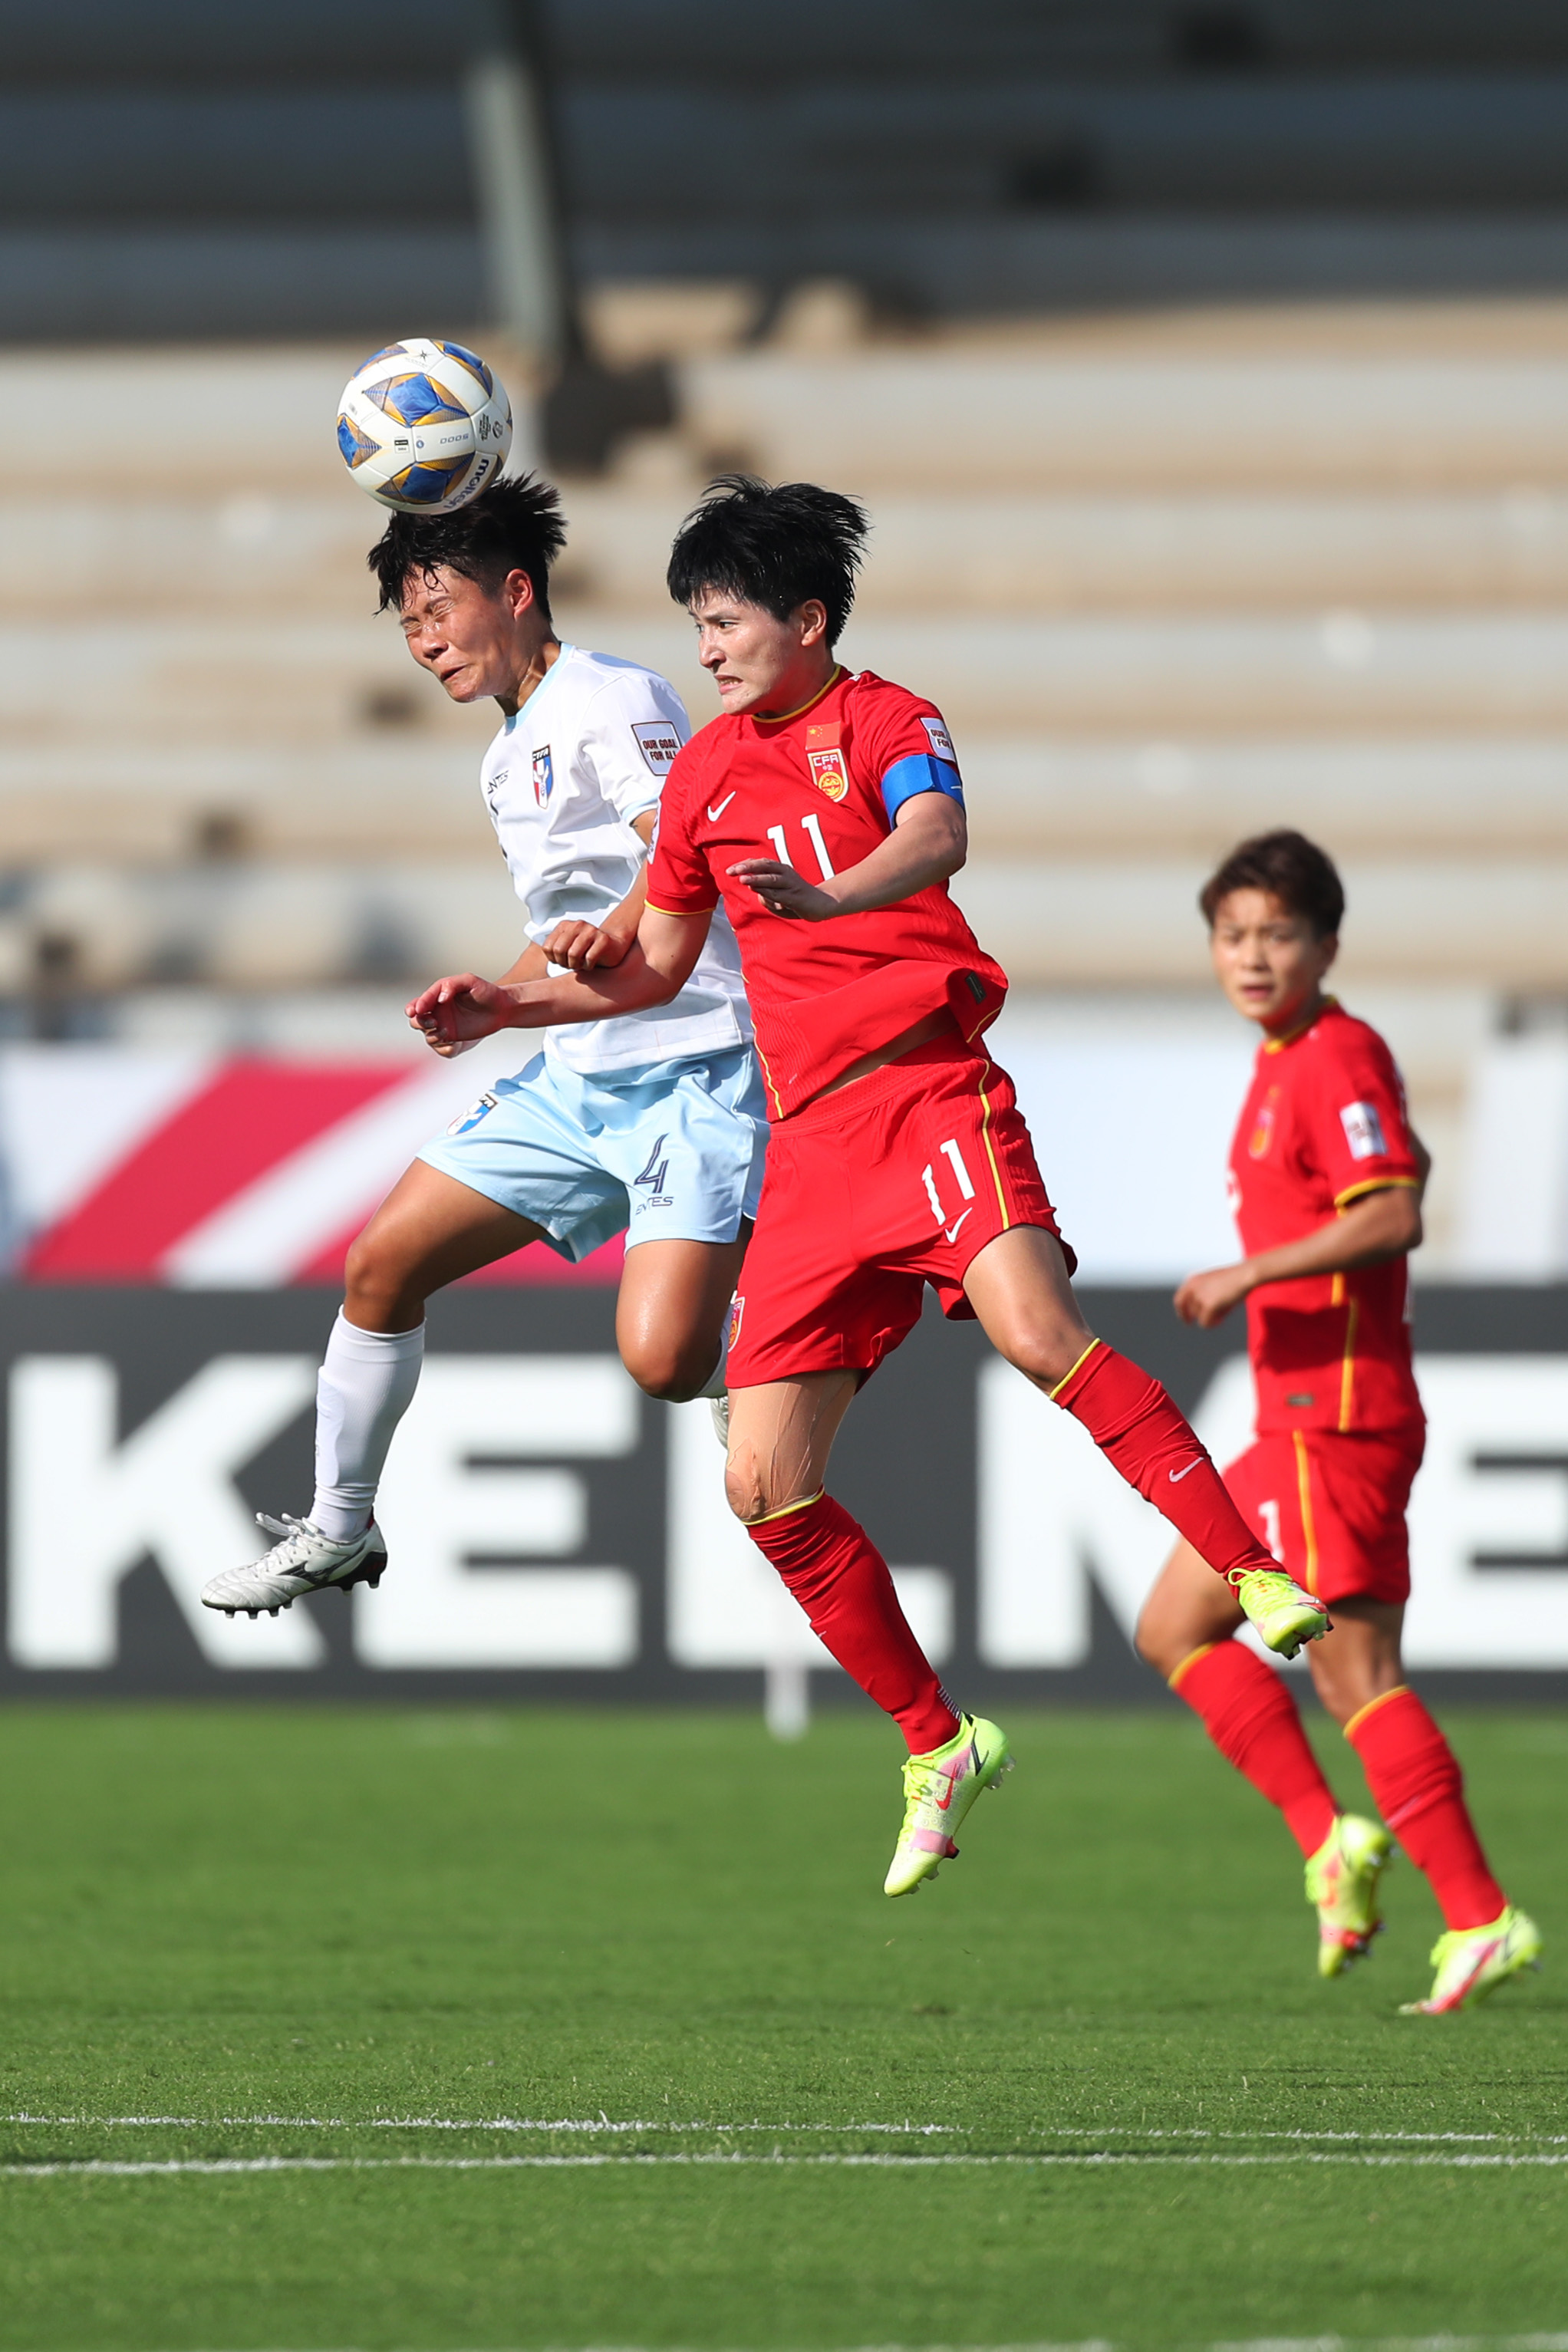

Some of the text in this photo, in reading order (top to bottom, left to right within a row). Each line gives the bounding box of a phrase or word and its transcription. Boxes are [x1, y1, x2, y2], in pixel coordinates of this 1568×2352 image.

[443, 459, 489, 509] molten
[642, 738, 678, 749] OUR GOAL
[650, 751, 665, 761] FOR
[813, 754, 839, 766] CFA
[767, 813, 836, 881] 11
[634, 1132, 670, 1194] 4
[921, 1138, 976, 1226] 11
